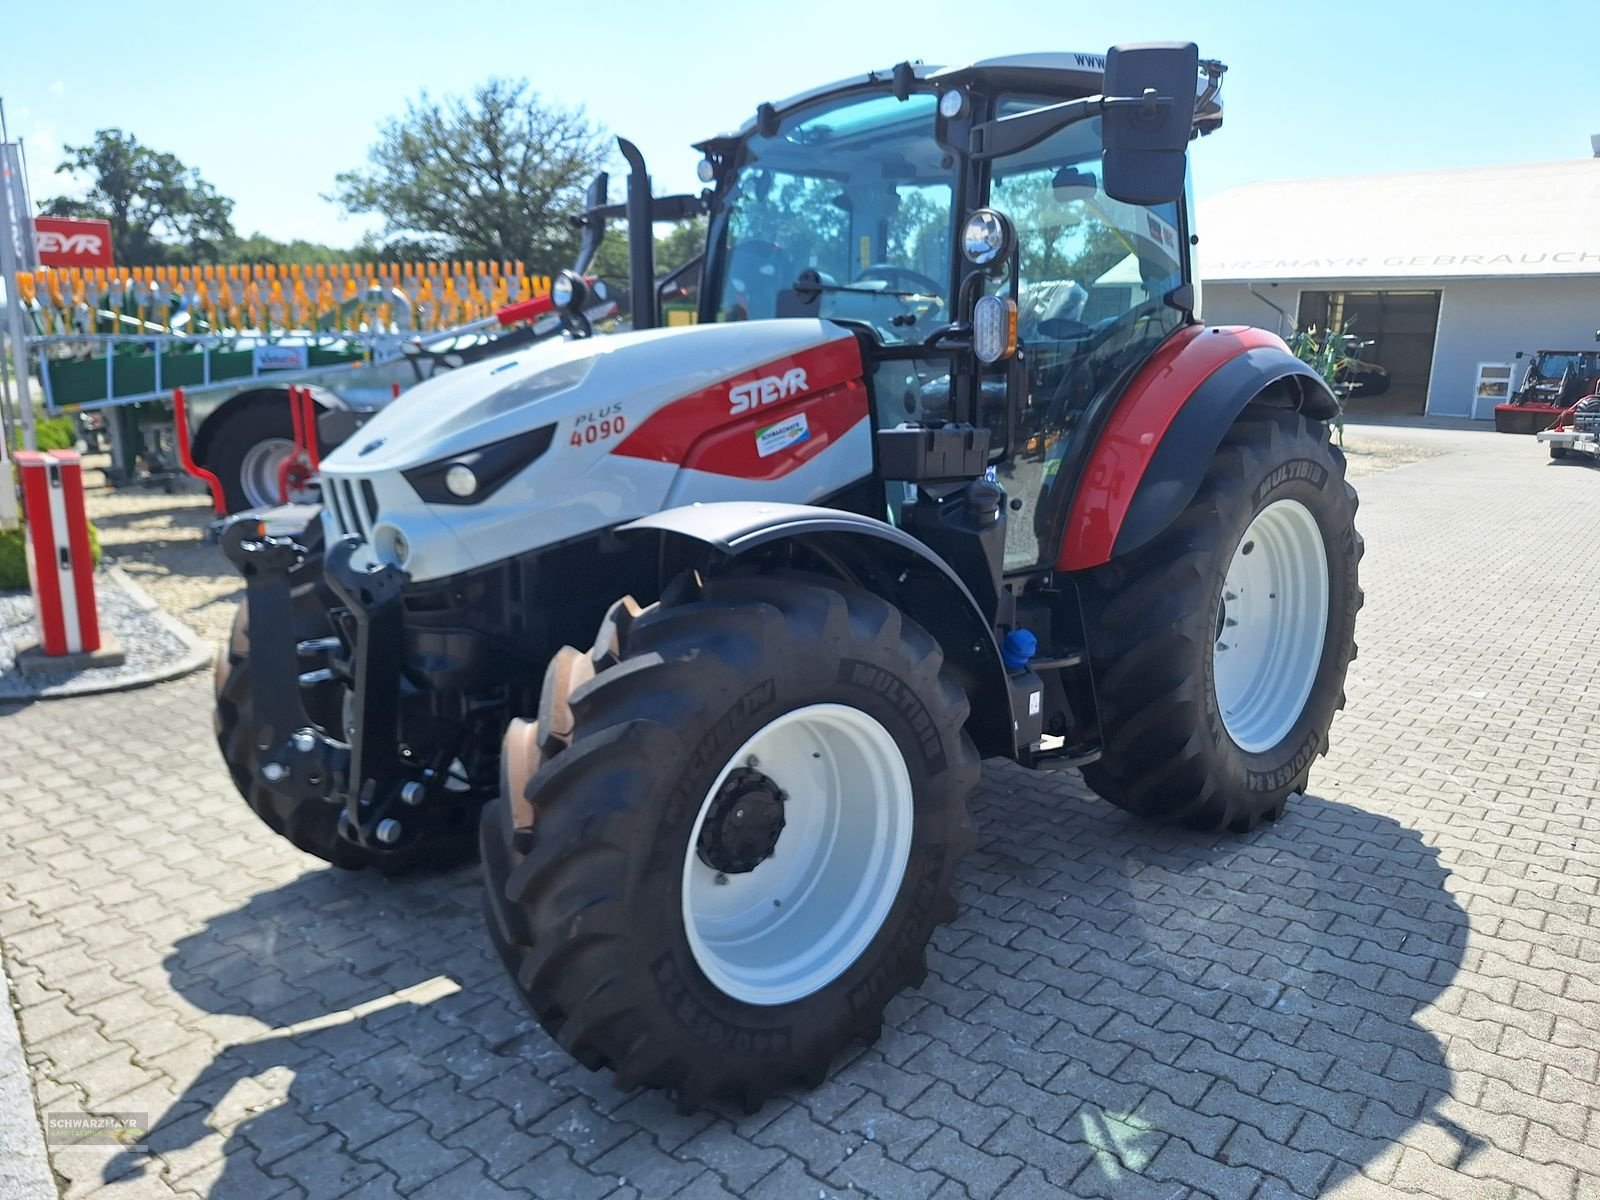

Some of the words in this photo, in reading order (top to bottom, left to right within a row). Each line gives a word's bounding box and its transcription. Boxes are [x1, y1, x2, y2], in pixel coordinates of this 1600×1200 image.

[35, 231, 102, 256] EYR
[1204, 257, 1368, 270] ARZMAYR
[728, 367, 810, 416] STEYR
[574, 402, 623, 427] PLUS
[570, 416, 625, 447] 4090
[1259, 461, 1322, 499] MULTIBIB
[851, 663, 941, 759] MULTIBIB
